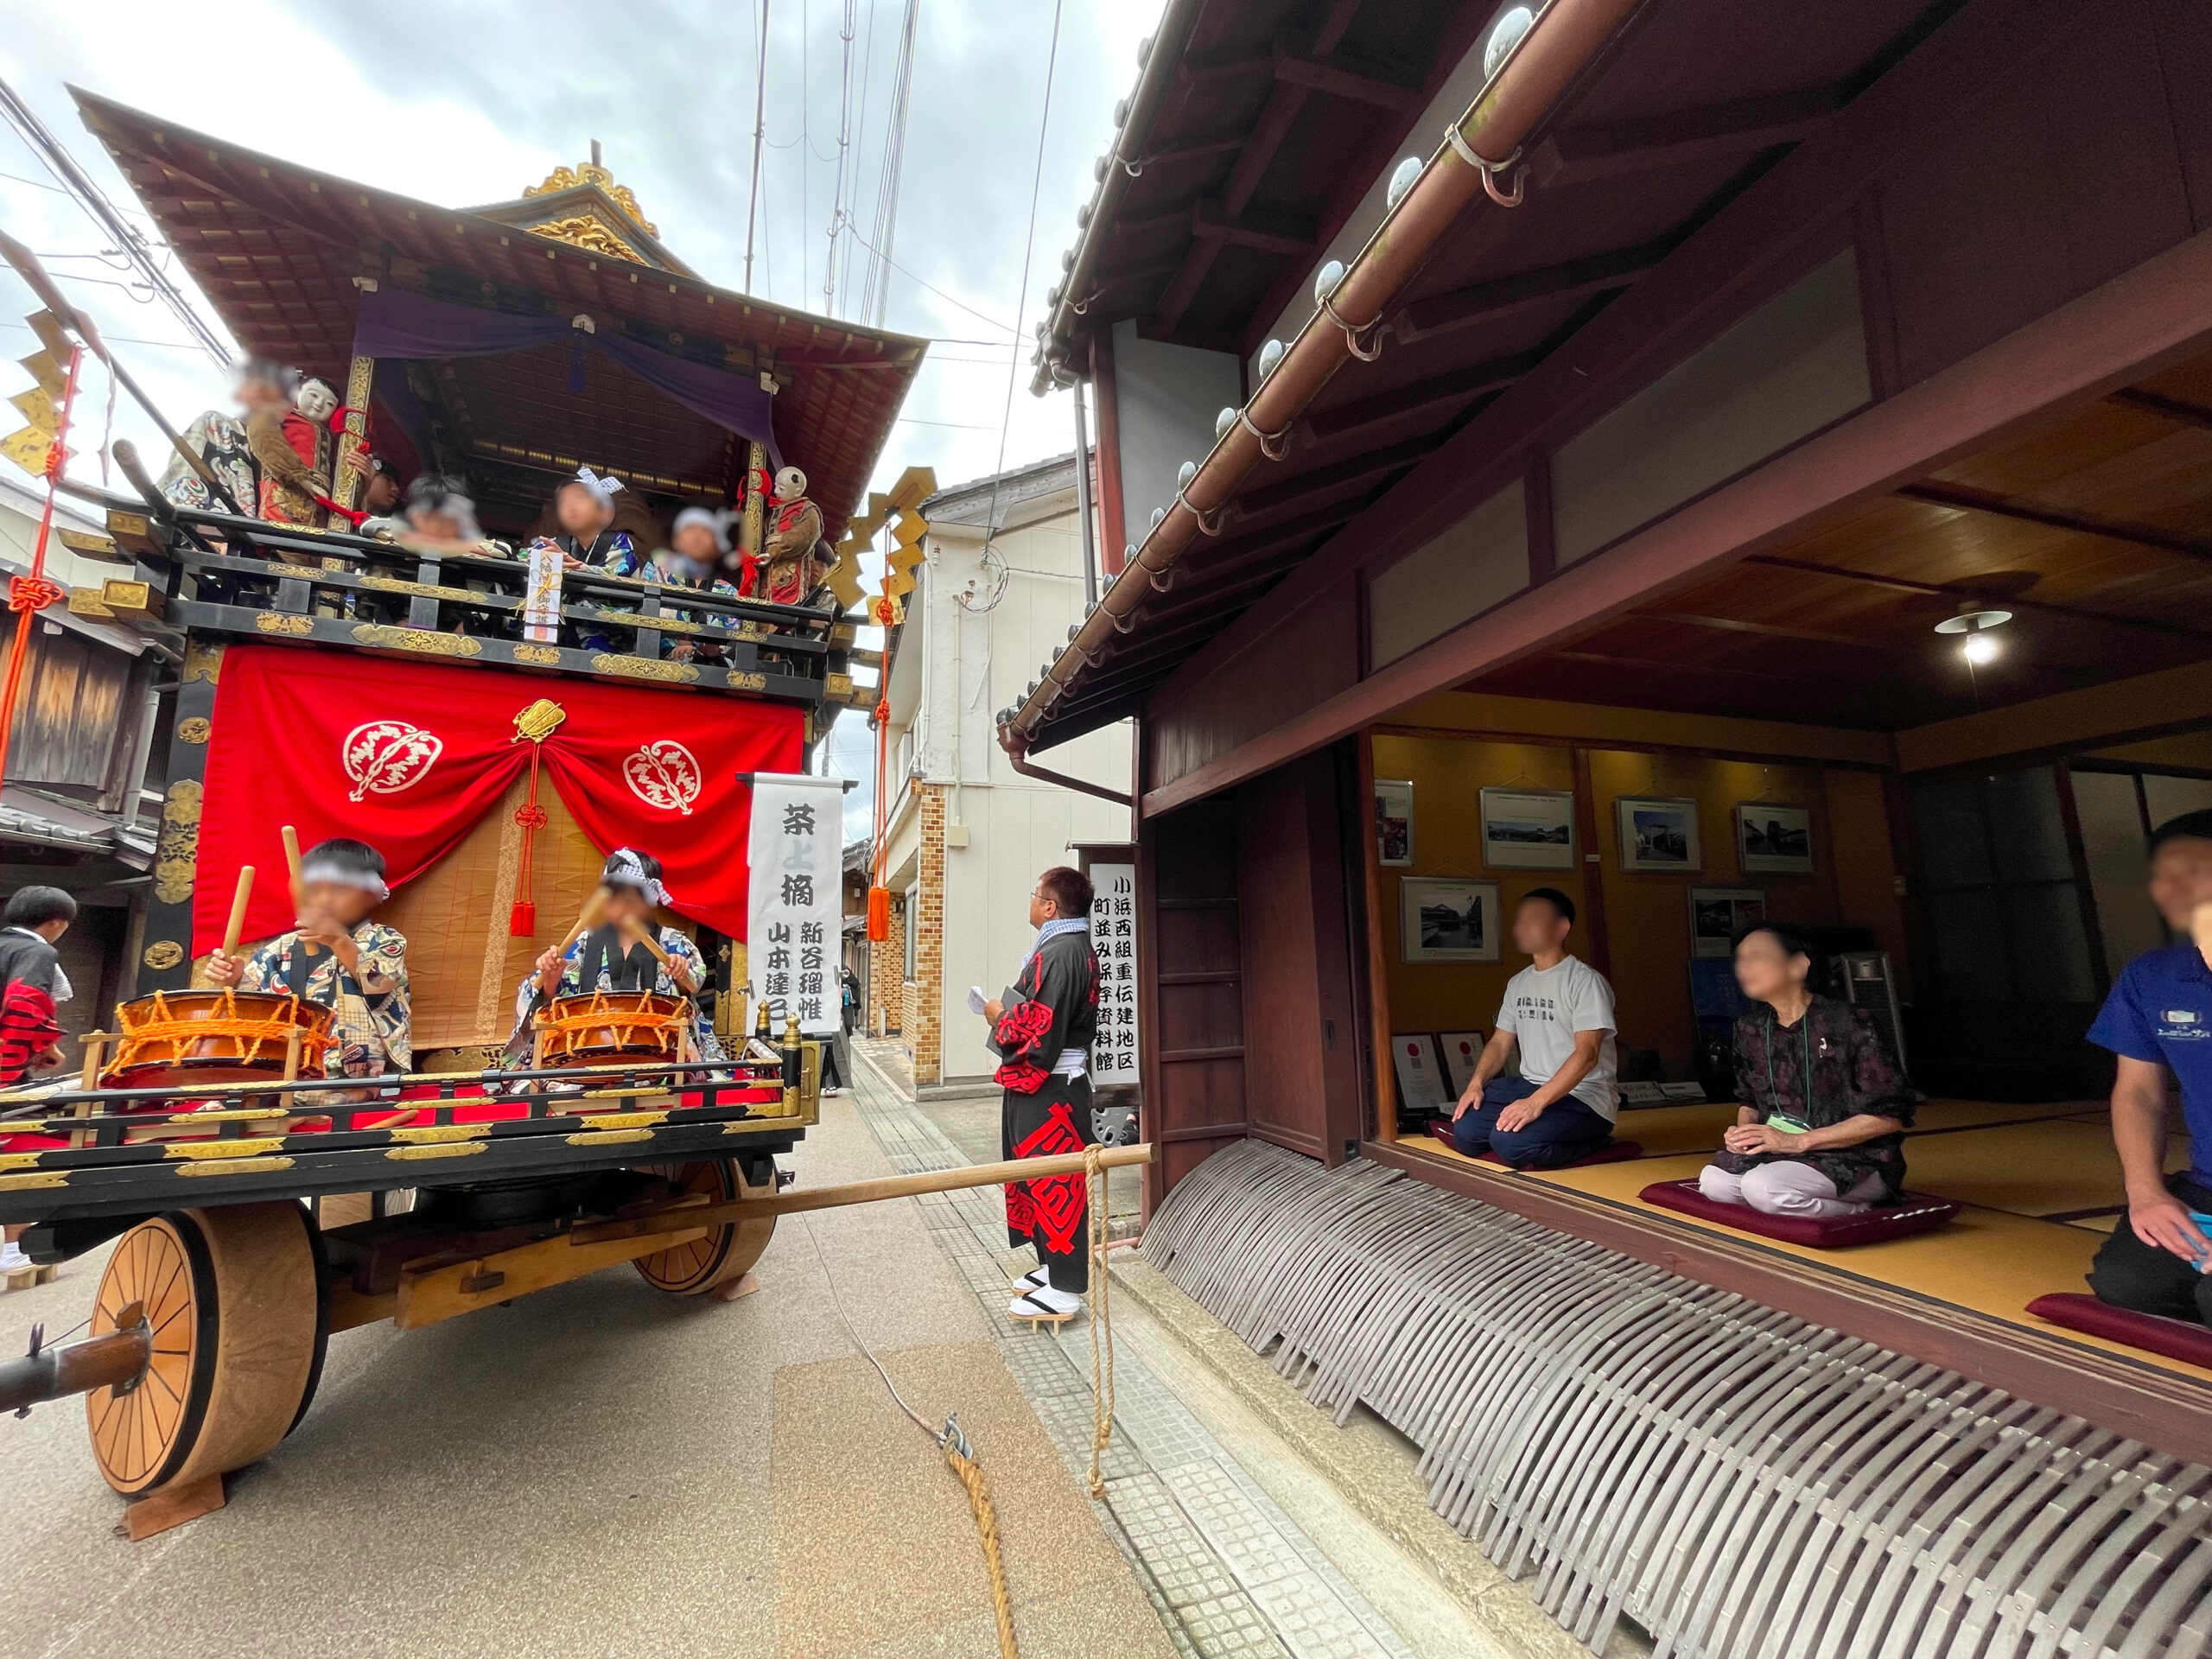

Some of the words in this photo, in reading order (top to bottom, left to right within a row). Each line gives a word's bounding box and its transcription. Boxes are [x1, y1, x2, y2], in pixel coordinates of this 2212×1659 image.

[1113, 875, 1135, 1070] 小浜西組重伝建地区
